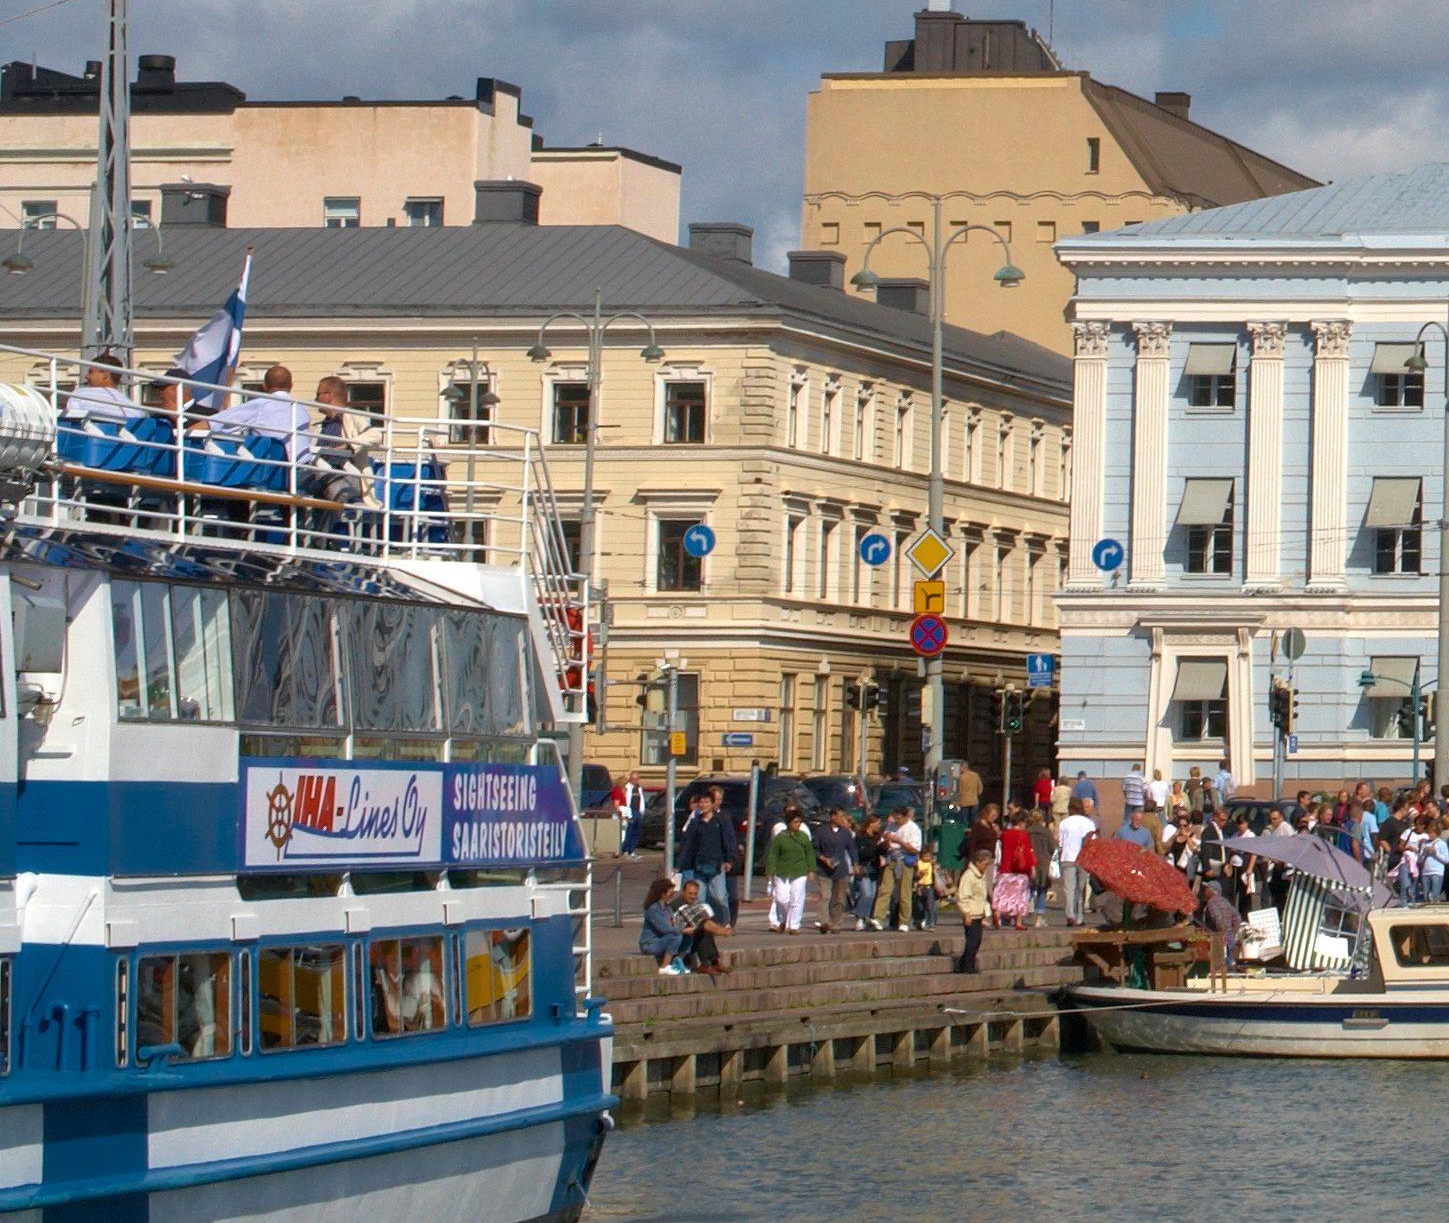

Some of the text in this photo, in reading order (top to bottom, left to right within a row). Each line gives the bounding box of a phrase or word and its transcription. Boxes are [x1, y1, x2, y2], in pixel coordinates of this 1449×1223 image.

[292, 774, 428, 840] IHA-Lines Oy
[453, 772, 537, 811] SIGHTSEEING
[452, 819, 568, 860] SAARISTORISTEILY
